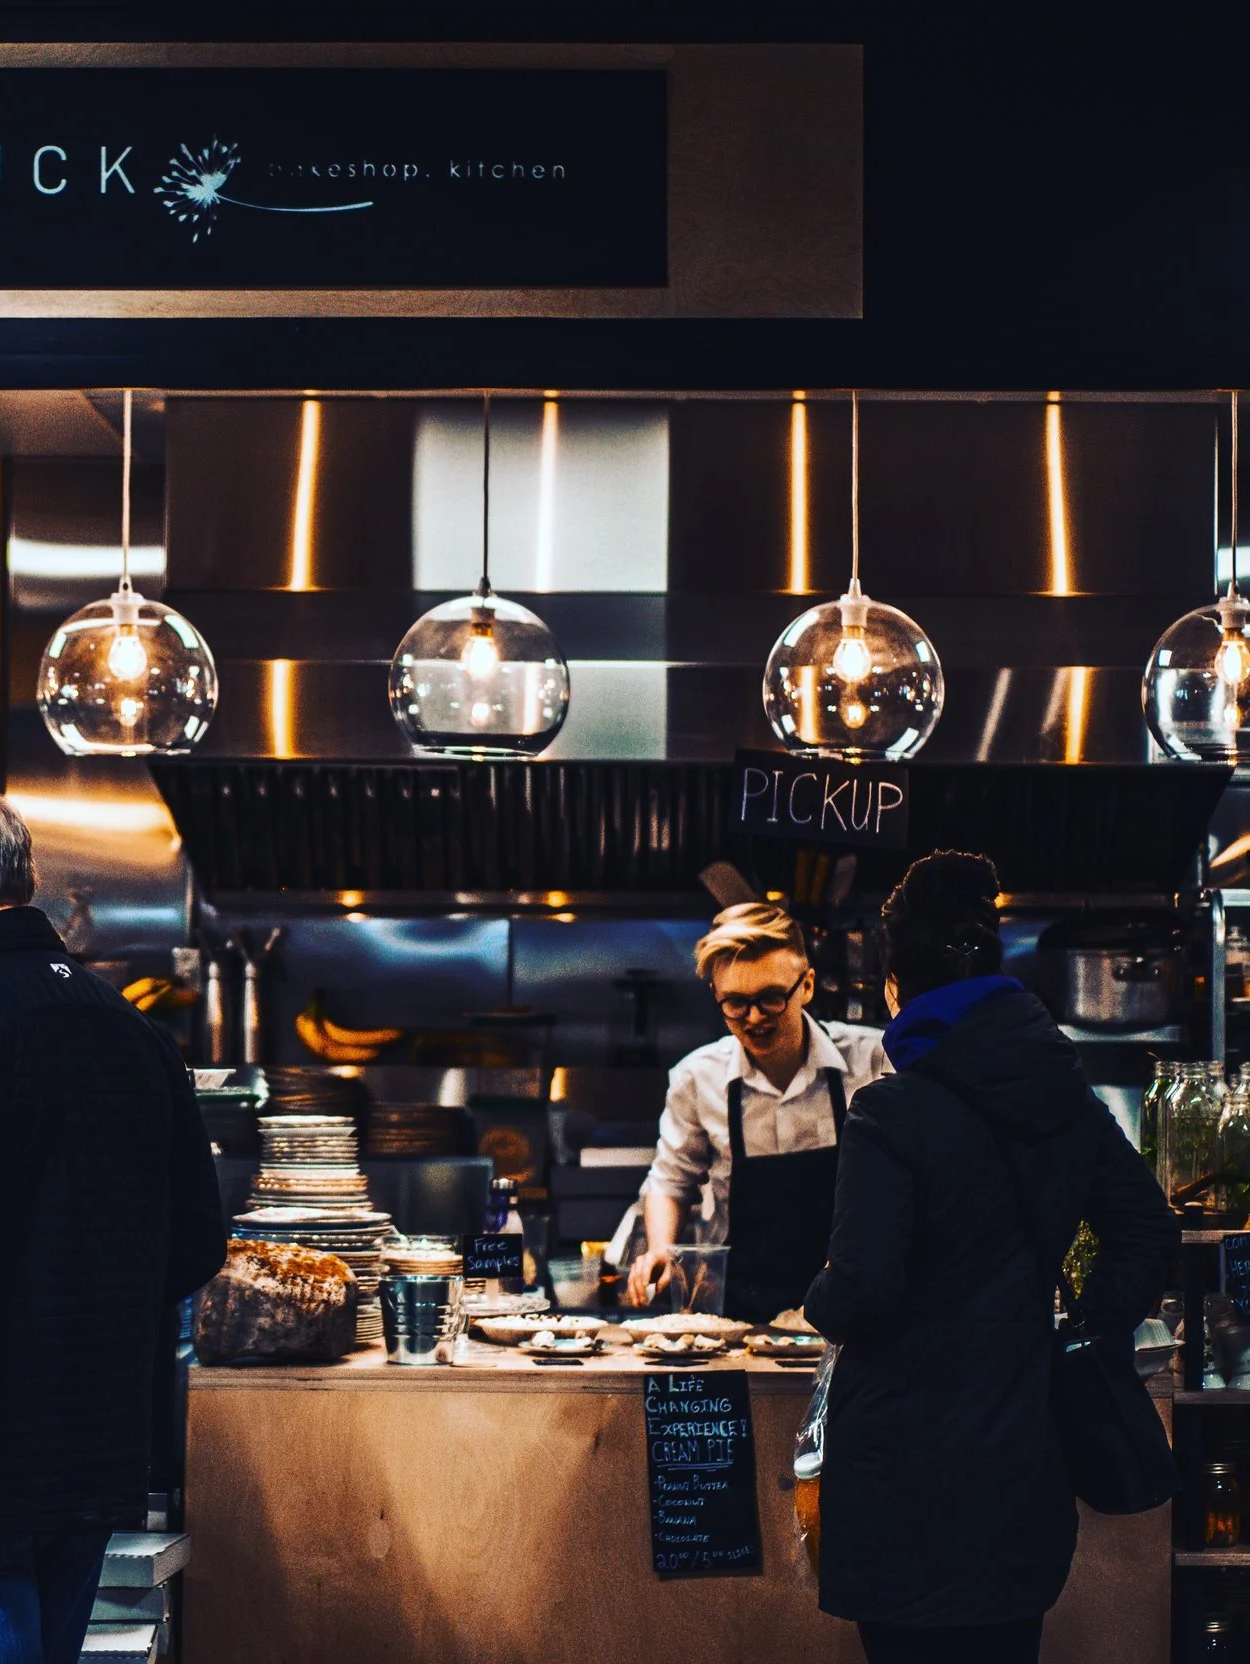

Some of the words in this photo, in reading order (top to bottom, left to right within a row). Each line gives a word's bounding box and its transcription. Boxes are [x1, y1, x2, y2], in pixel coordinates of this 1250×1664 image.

[449, 160, 567, 179] kitchen
[740, 767, 904, 833] PICKUP
[474, 1237, 509, 1253] Free
[467, 1255, 520, 1273] Samples
[648, 1376, 661, 1393] A
[668, 1374, 705, 1393] LIFE
[645, 1396, 732, 1414] CHANGING
[648, 1417, 748, 1438] EXPERIENCE!
[652, 1439, 701, 1461] CREAM
[708, 1439, 735, 1462] PIE
